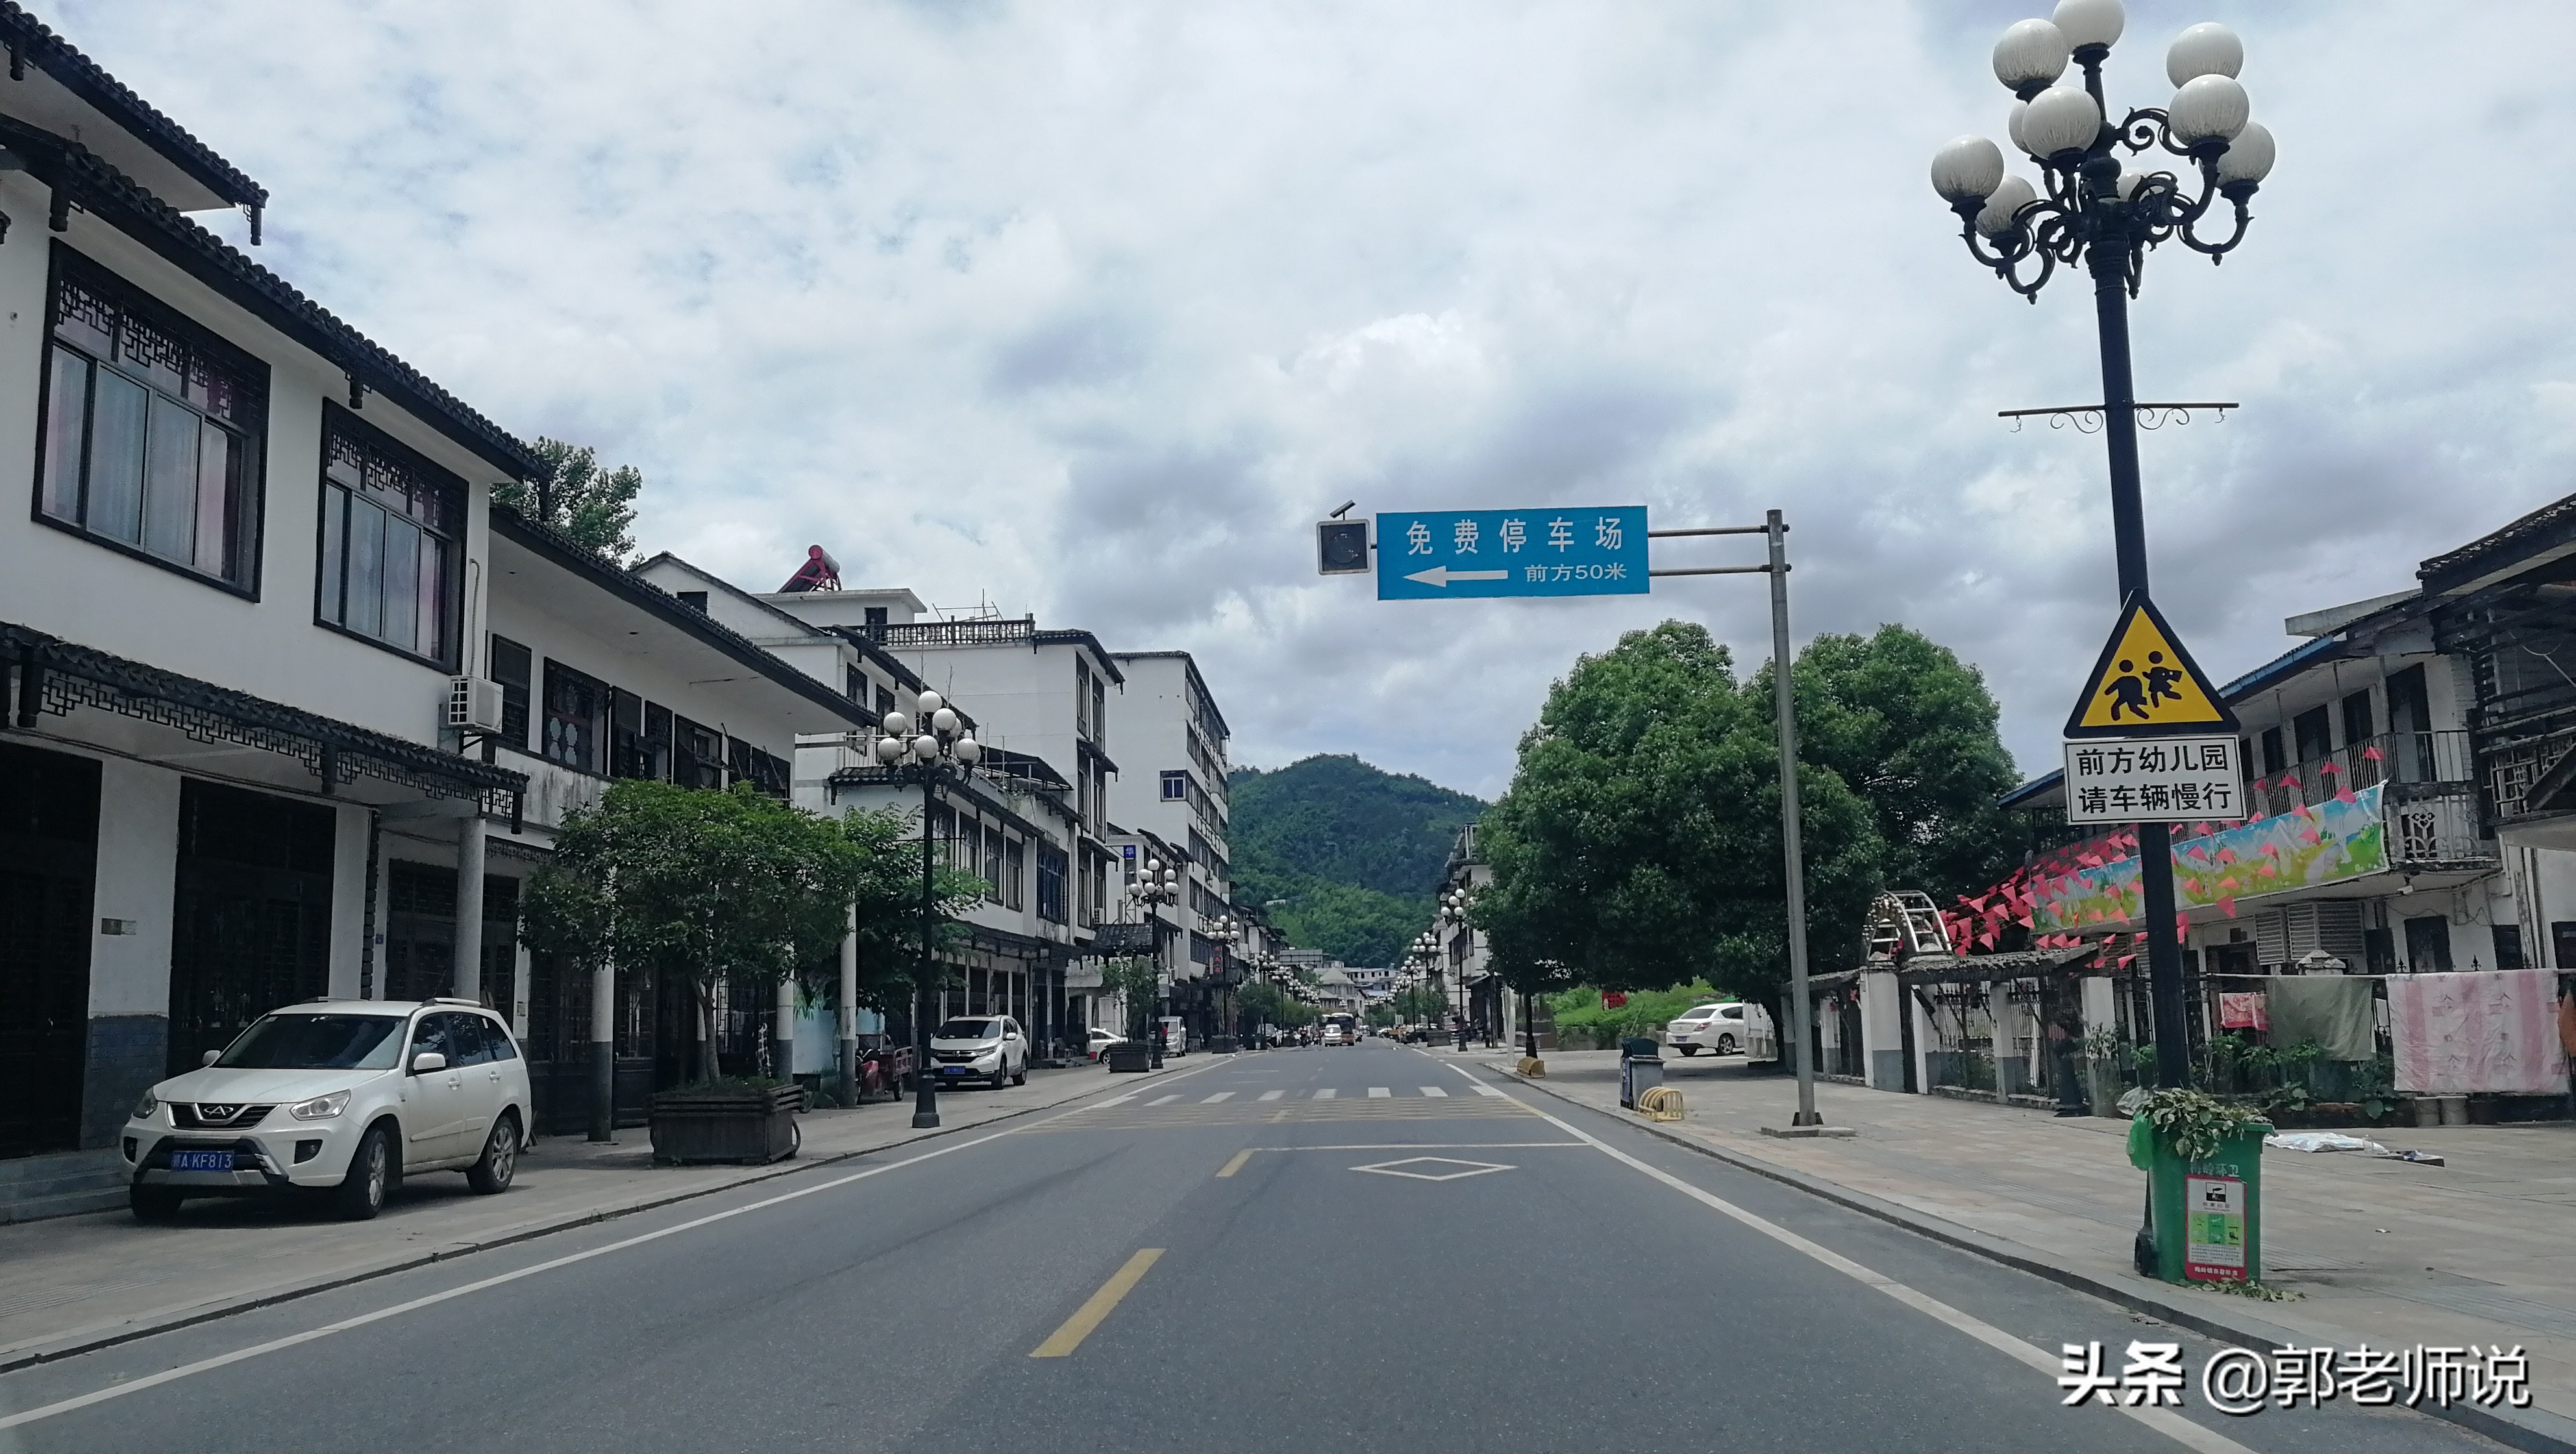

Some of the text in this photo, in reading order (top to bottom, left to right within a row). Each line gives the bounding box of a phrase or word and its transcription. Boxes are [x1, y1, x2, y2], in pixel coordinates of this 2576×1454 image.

[1406, 516, 1622, 556] 免费停车场
[1524, 563, 1628, 582] 前方50米
[2076, 745, 2229, 776] 前方幼儿园
[2078, 782, 2232, 814] 请车辆慢行
